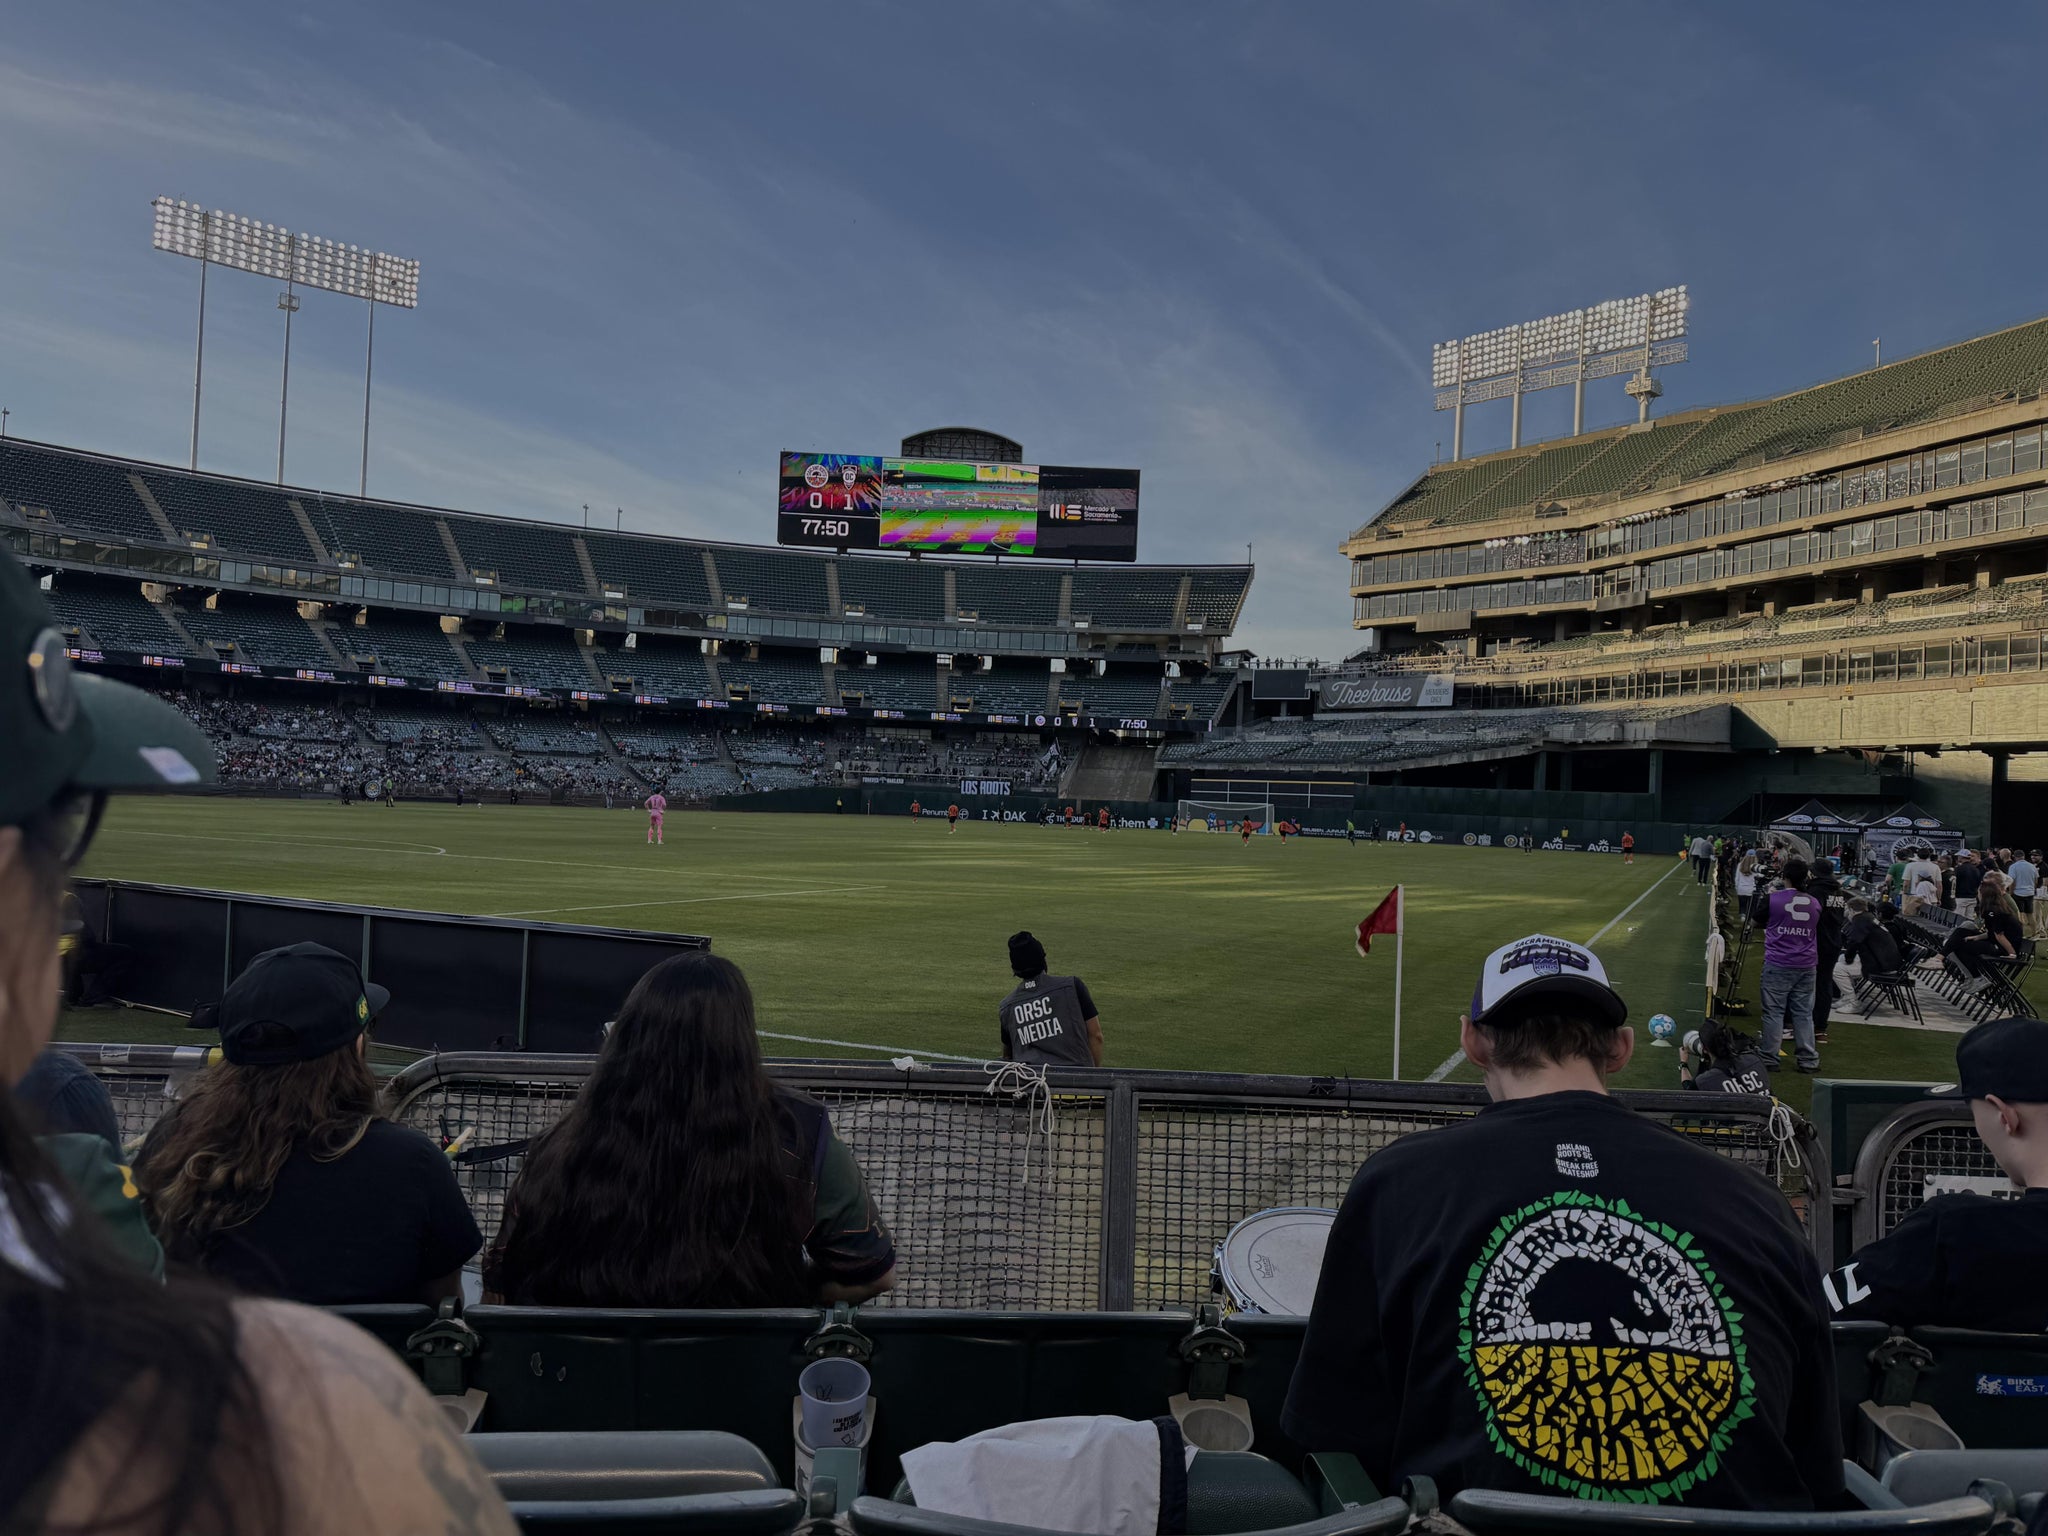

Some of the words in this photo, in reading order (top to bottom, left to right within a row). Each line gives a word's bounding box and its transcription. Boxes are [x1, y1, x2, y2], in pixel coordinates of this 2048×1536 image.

[810, 492, 823, 509] 0
[843, 494, 854, 511] 1
[801, 519, 850, 537] 77:50
[1326, 680, 1413, 707] Treehouse
[1054, 717, 1062, 727] 0
[1089, 718, 1096, 728] 1
[1120, 720, 1148, 729] 77:50
[960, 781, 978, 795] LOS
[979, 781, 1011, 796] ROOTS
[1003, 811, 1027, 822] OAK
[1542, 840, 1563, 850] Ava
[1588, 843, 1610, 853] Ava
[1777, 926, 1812, 937] CHARLY
[1514, 938, 1572, 949] SACRAMENTO
[1500, 944, 1590, 974] KINGS
[1014, 996, 1053, 1025] ORSC
[1017, 1017, 1064, 1046] MEDIA
[1556, 1143, 1591, 1153] OAKLAND
[1557, 1150, 1582, 1158] ROOTS
[1582, 1152, 1594, 1161] SC
[1555, 1158, 1581, 1170] BREAK
[1581, 1161, 1600, 1170] FREE
[1557, 1165, 1600, 1178] SKATESHOP
[2007, 1378, 2035, 1386] BIKE
[2015, 1384, 2046, 1393] EAST
